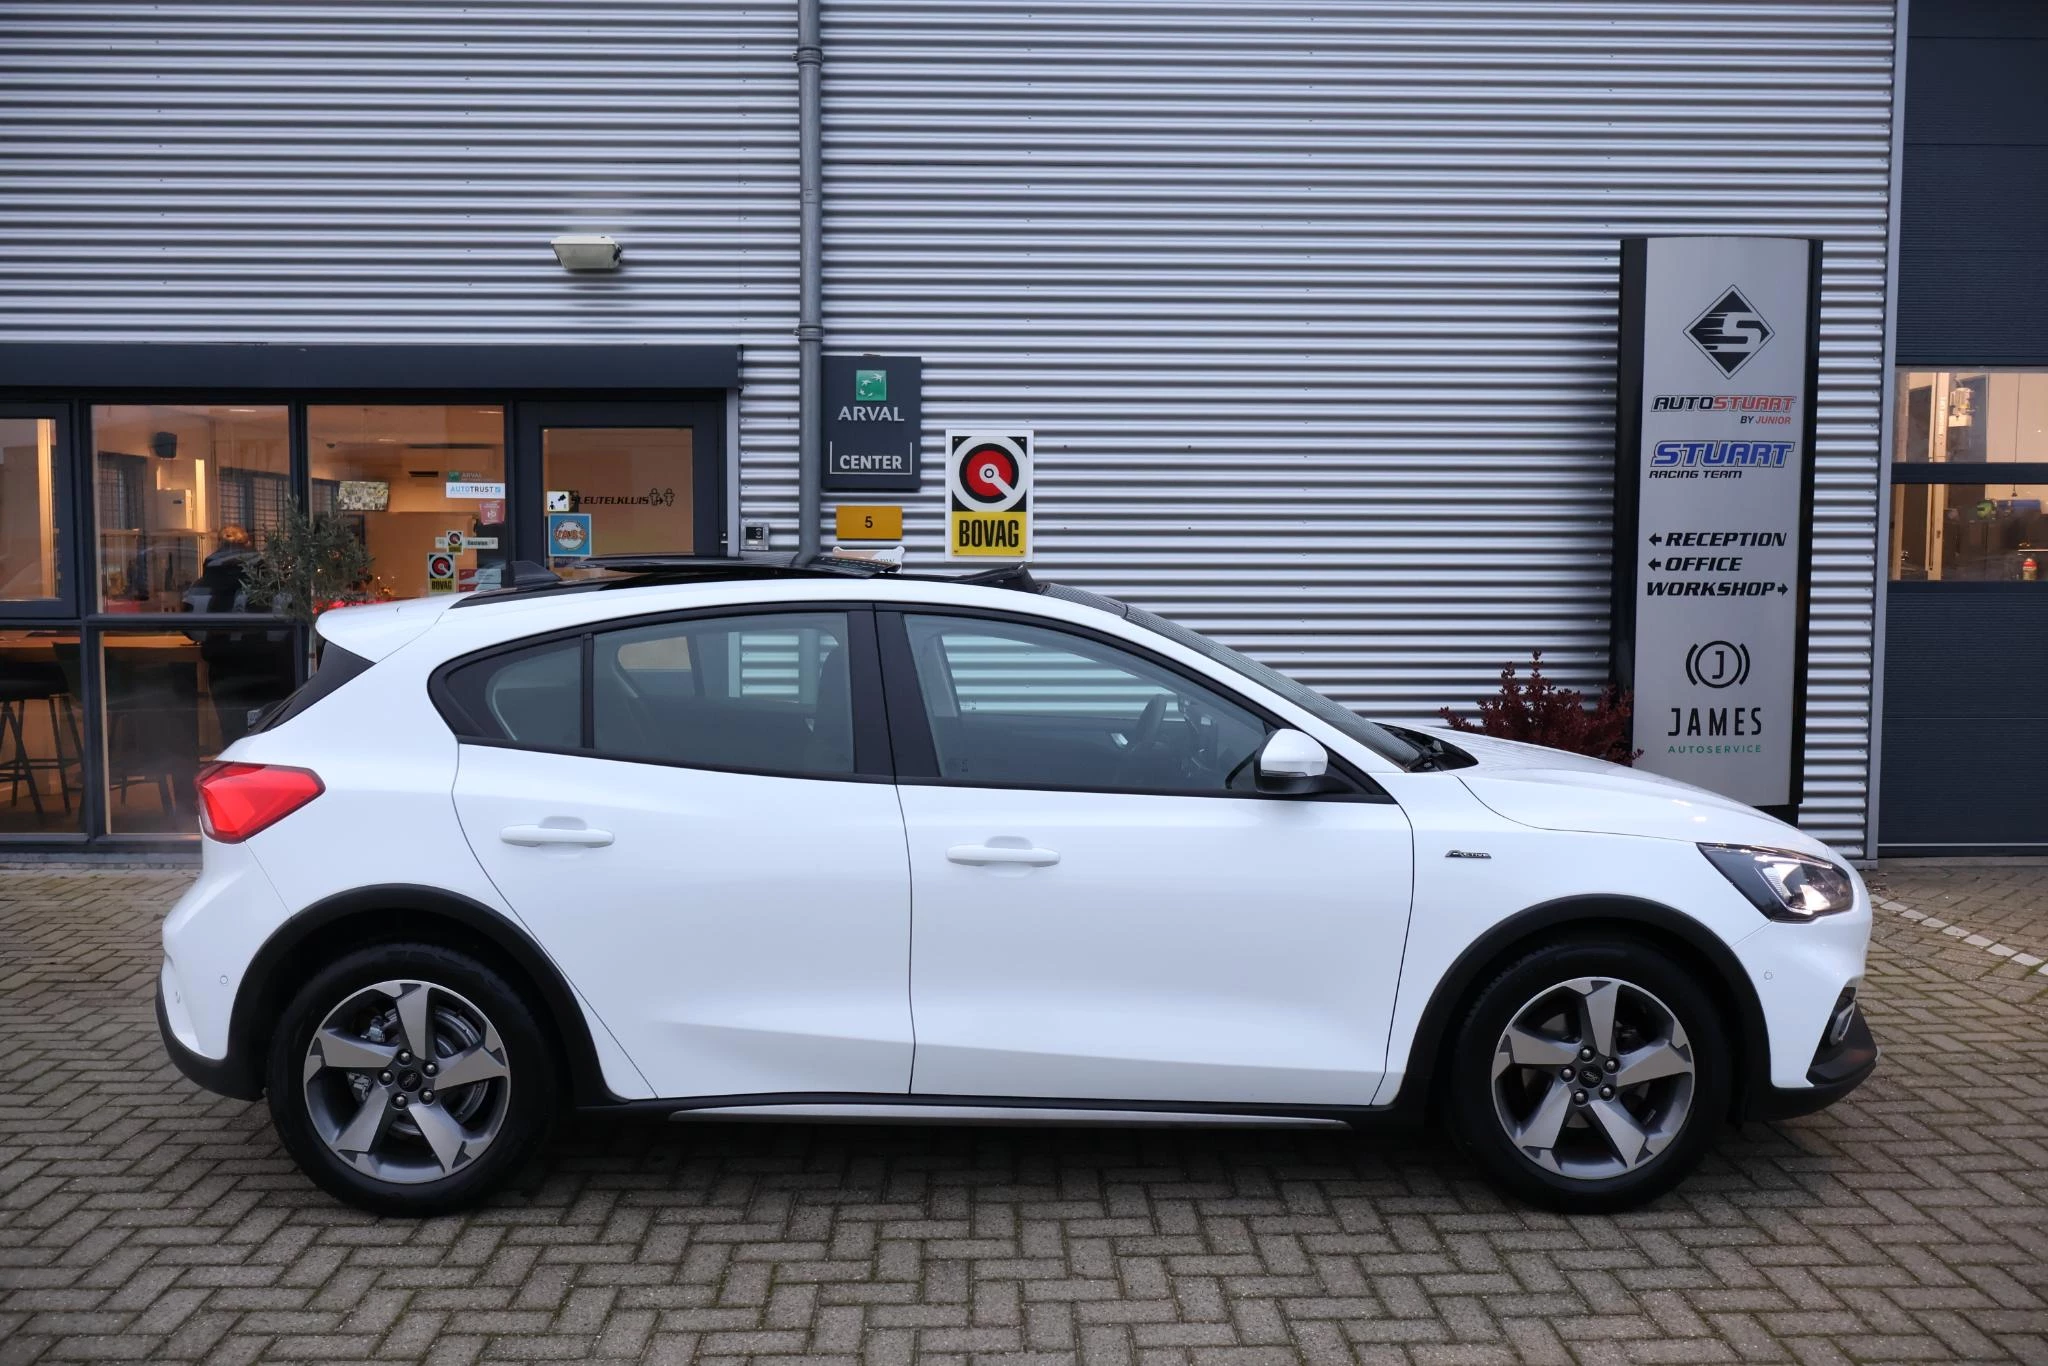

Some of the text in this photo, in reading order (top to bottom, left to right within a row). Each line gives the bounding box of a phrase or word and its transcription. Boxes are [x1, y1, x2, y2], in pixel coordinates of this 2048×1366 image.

[1651, 395, 1795, 412] AUTOSTUART
[837, 406, 904, 422] ARVAL
[1740, 415, 1792, 425] BY JUNIOR
[1651, 441, 1795, 468] STUART
[839, 455, 903, 470] CENTER
[1649, 470, 1743, 479] RACING TEAM
[864, 515, 873, 529] 5
[958, 519, 1020, 548] BOVAG
[1665, 532, 1787, 547] RECEPTION
[1664, 557, 1743, 571] OFFICE
[432, 580, 453, 591] BOVAG
[1646, 582, 1776, 597] WORKSHOP
[1667, 707, 1762, 736] JAMES
[1668, 744, 1762, 753] AUTOSERVICE
